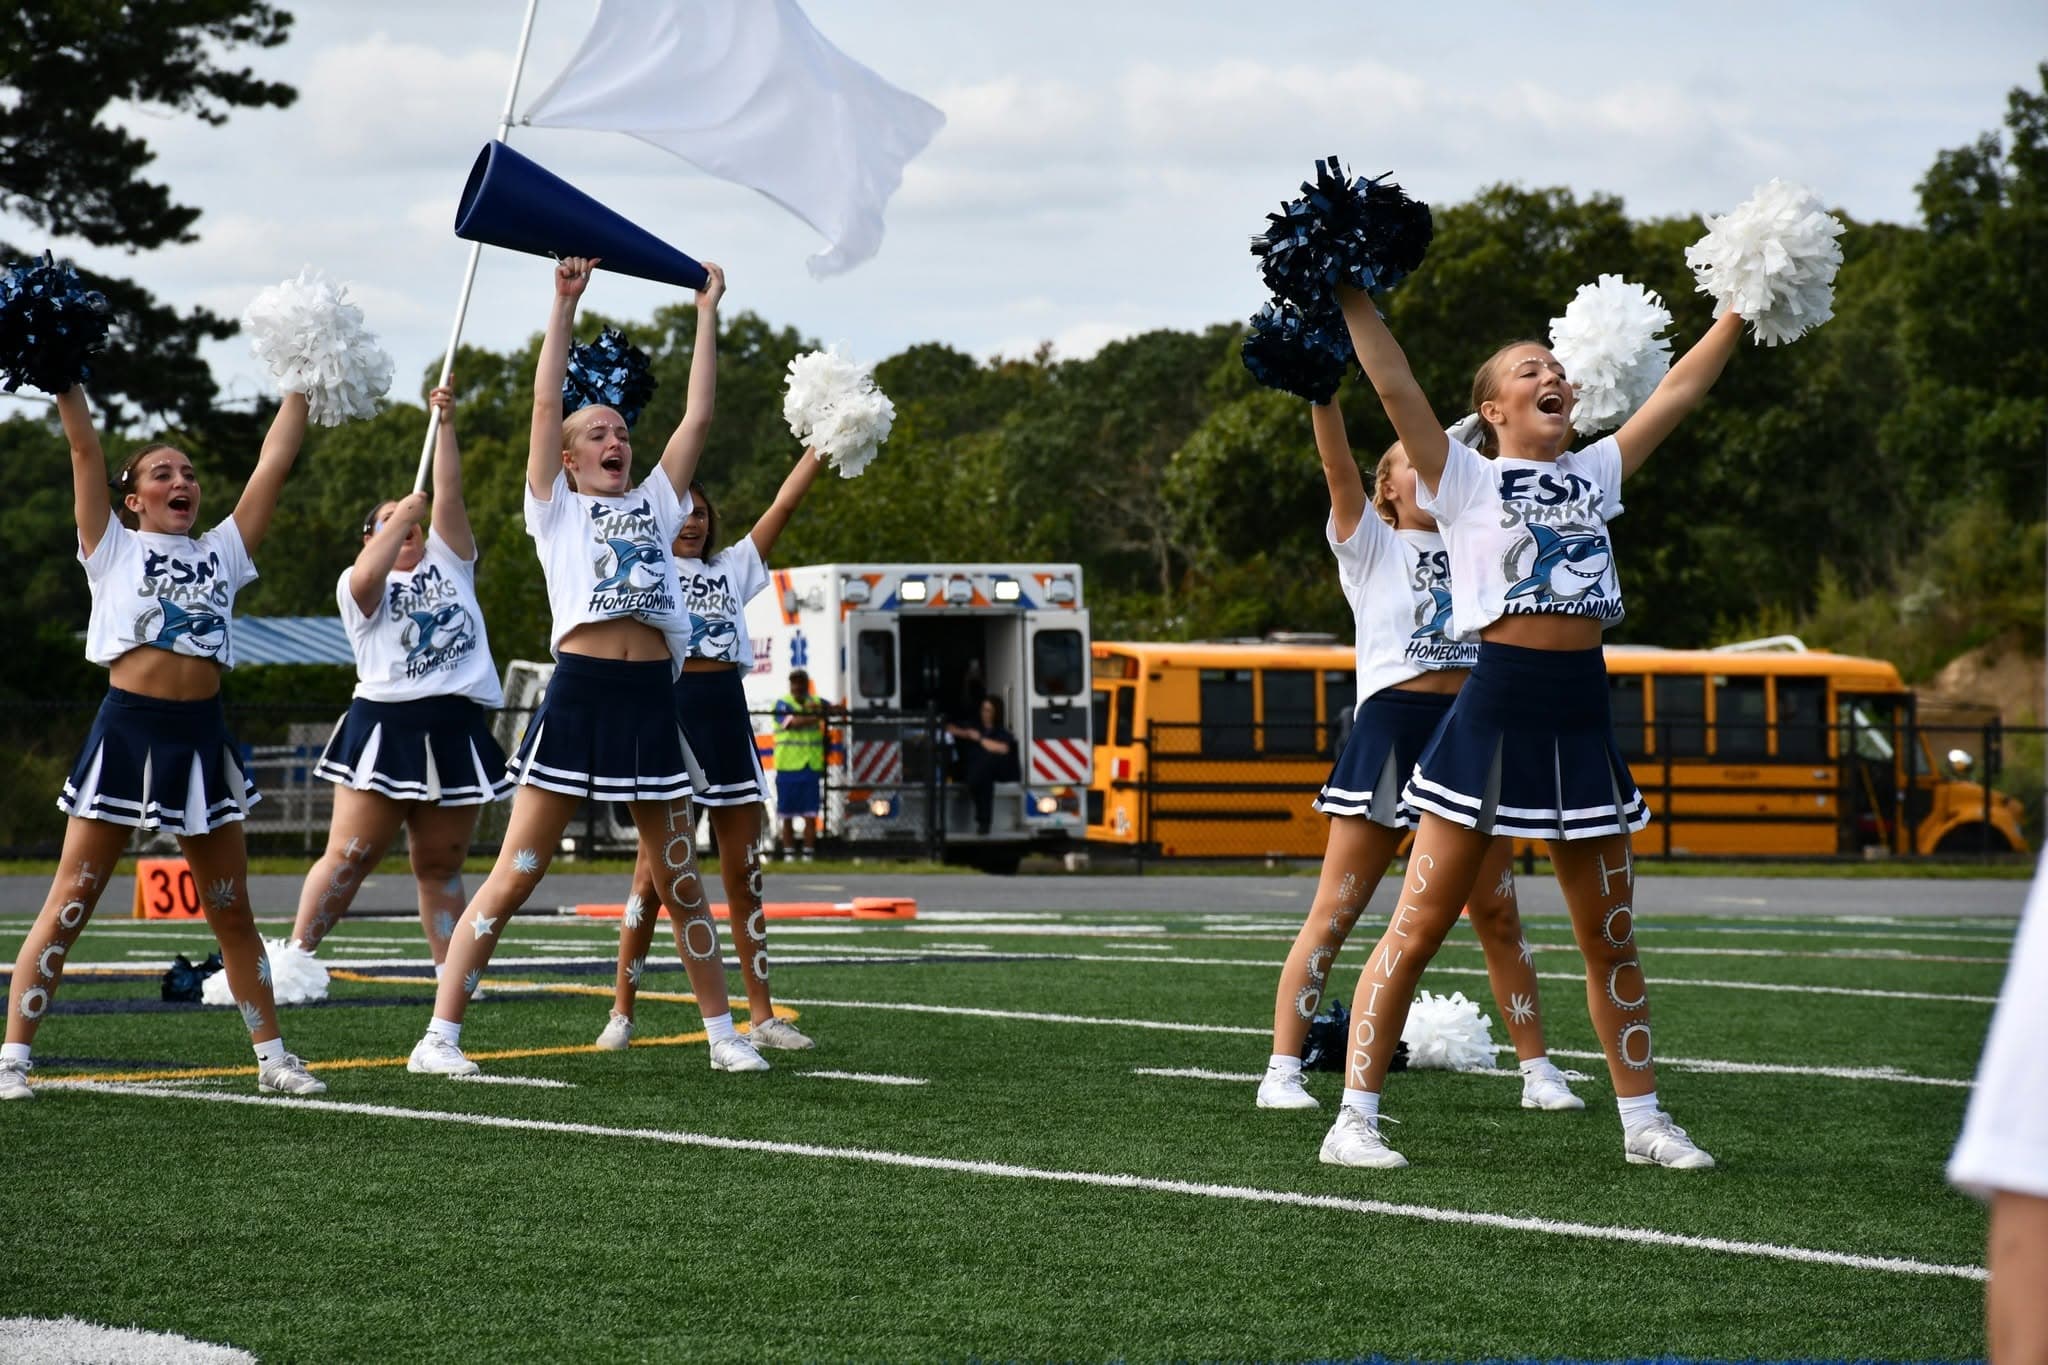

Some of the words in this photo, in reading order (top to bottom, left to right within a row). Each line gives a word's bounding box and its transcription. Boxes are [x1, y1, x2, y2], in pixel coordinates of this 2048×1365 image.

[1500, 494, 1605, 529] SHARK
[145, 549, 219, 584] ESM
[390, 564, 442, 604] ESM
[684, 594, 737, 615] HARKS
[1405, 641, 1481, 661] HOMECOMIN
[151, 869, 201, 915] 30
[1349, 854, 1435, 1089] SENIOR
[1597, 844, 1653, 1071] HOCO
